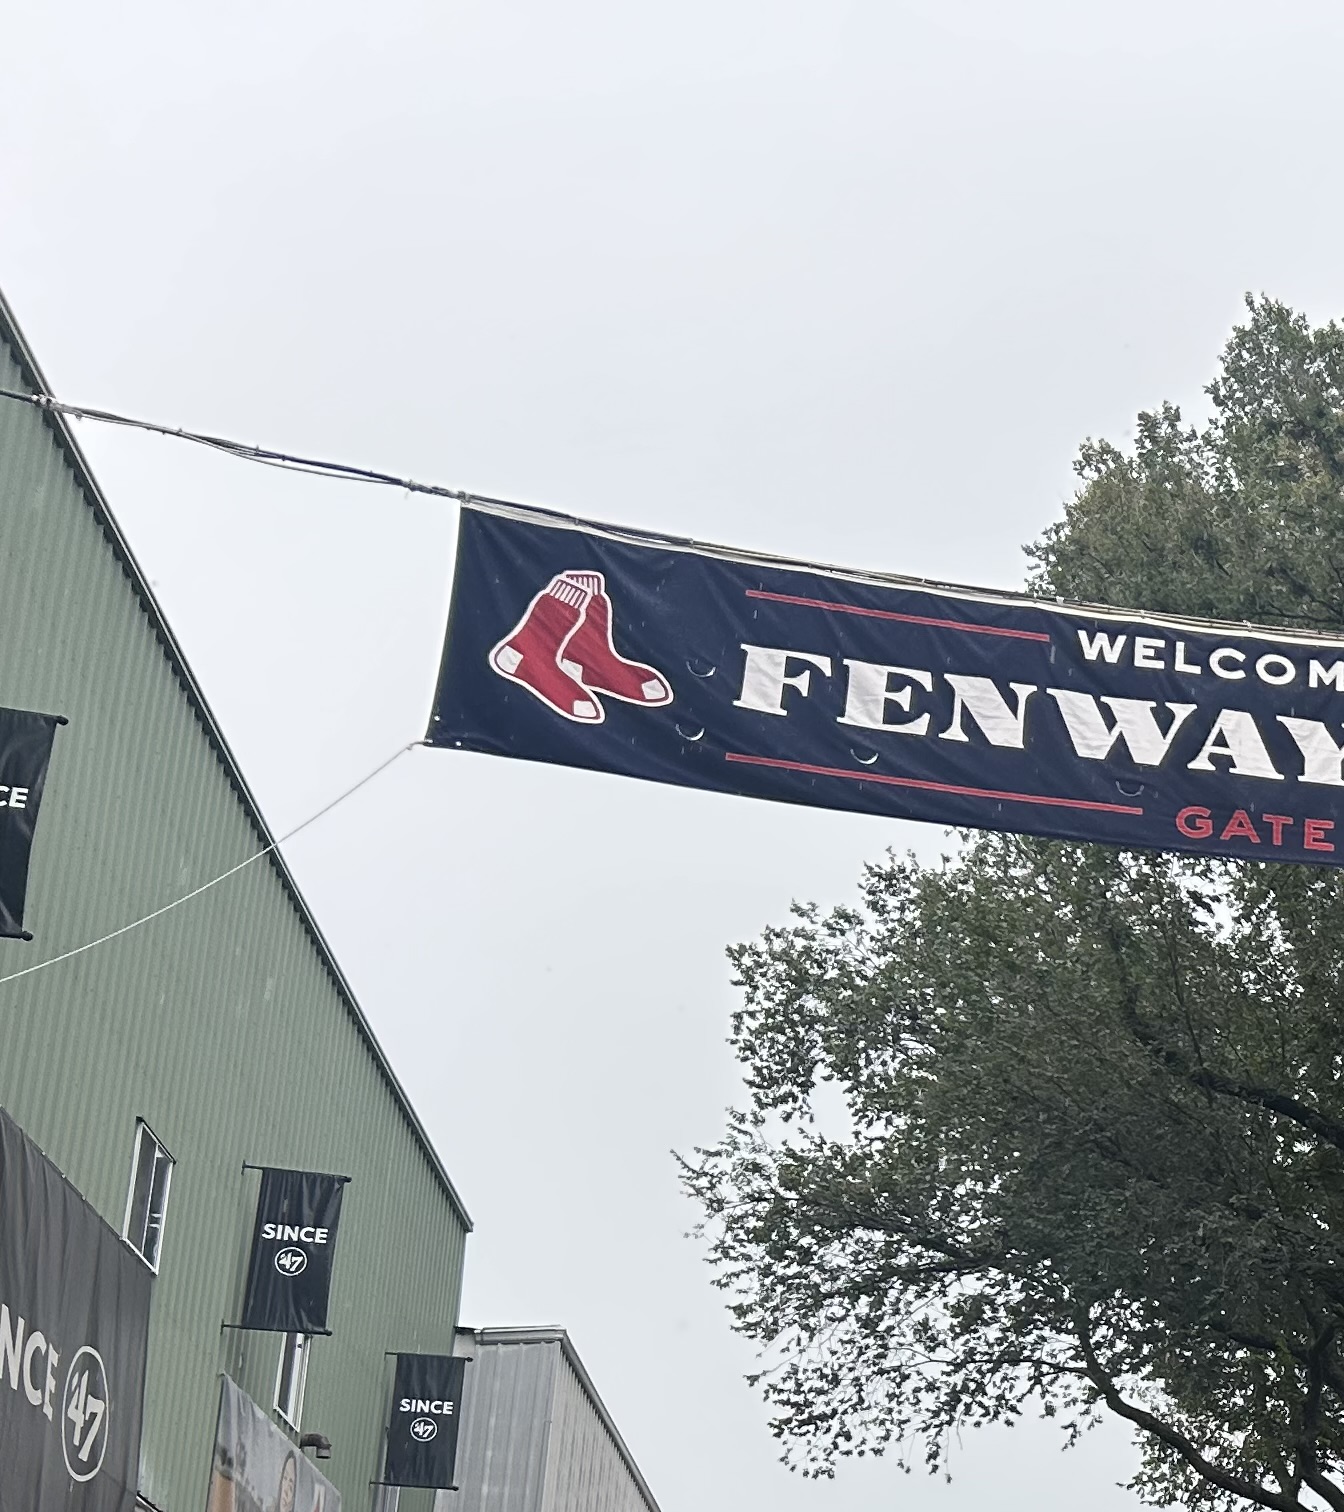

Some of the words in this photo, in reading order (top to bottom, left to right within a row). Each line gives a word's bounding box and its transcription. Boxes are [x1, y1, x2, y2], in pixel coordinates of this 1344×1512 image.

[1175, 805, 1336, 853] GATE
[261, 1222, 329, 1245] SINCE
[399, 1397, 454, 1416] SINCE
